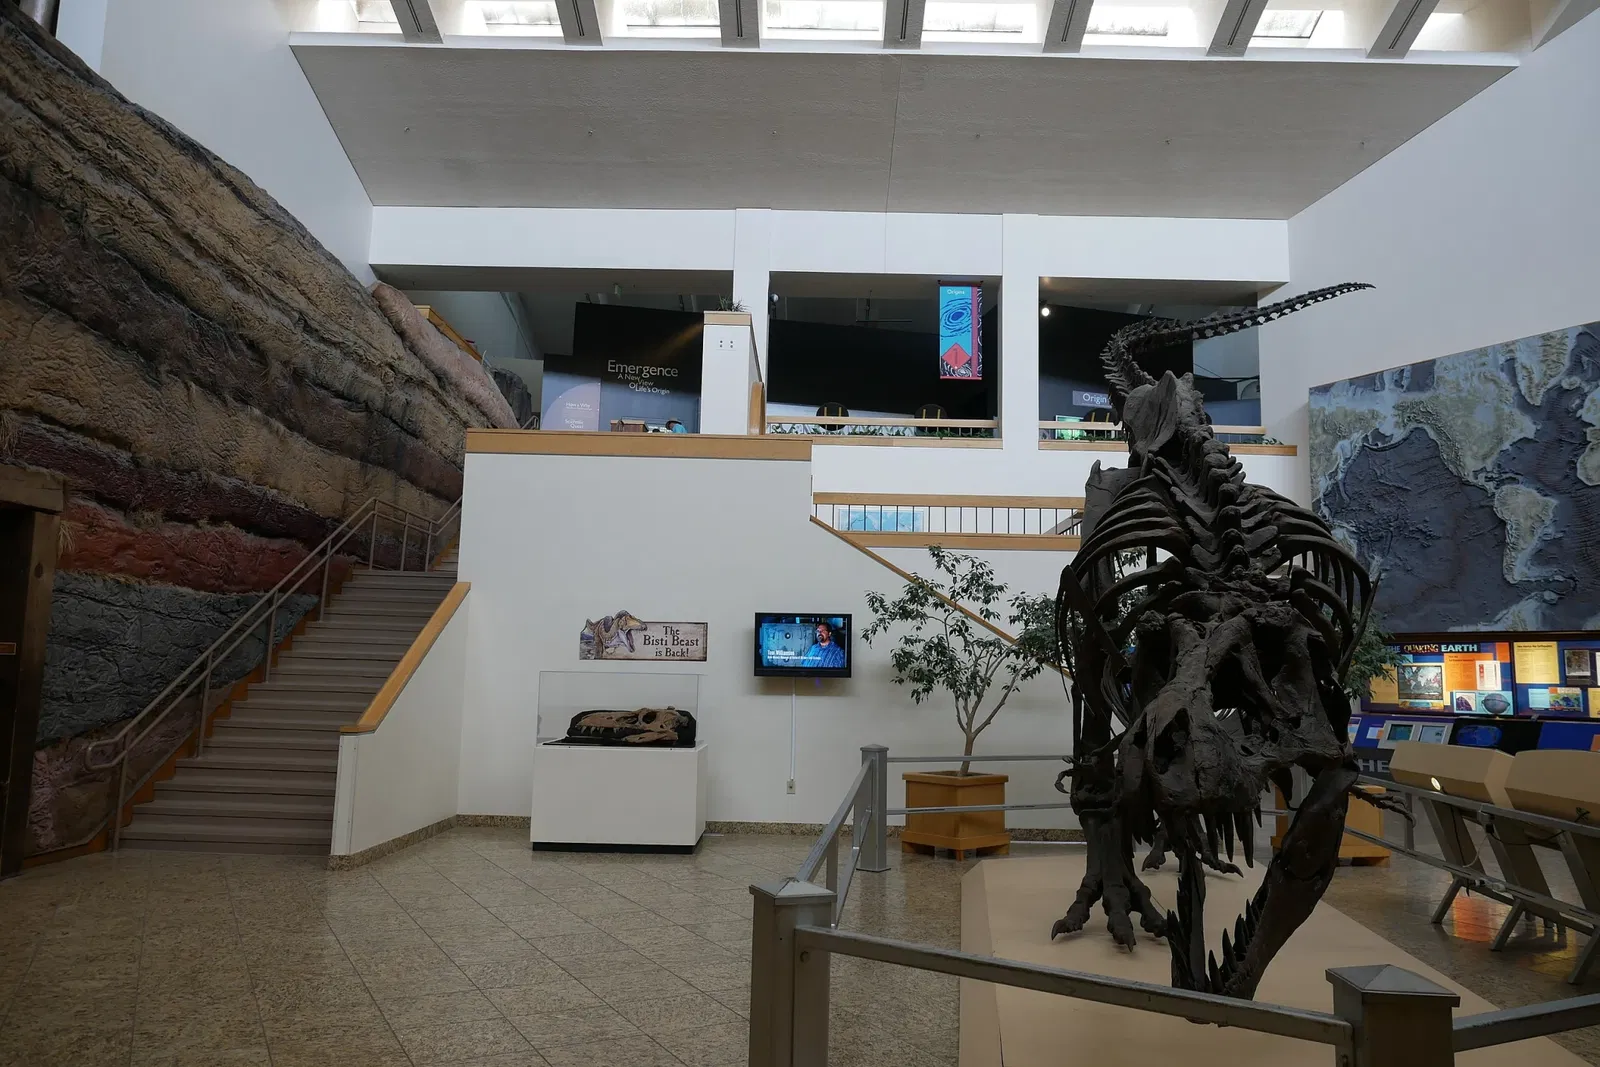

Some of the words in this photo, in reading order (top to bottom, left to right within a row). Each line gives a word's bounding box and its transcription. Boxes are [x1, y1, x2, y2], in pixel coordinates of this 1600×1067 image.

[607, 360, 679, 378] Emergence
[637, 378, 654, 386] View
[651, 387, 670, 396] Origin
[662, 625, 681, 636] The
[643, 634, 668, 647] Bisti
[672, 635, 700, 647] Beast
[654, 648, 663, 658] is
[664, 647, 690, 658] Back!
[1403, 643, 1439, 653] QUAKING
[1441, 644, 1477, 652] EARTH
